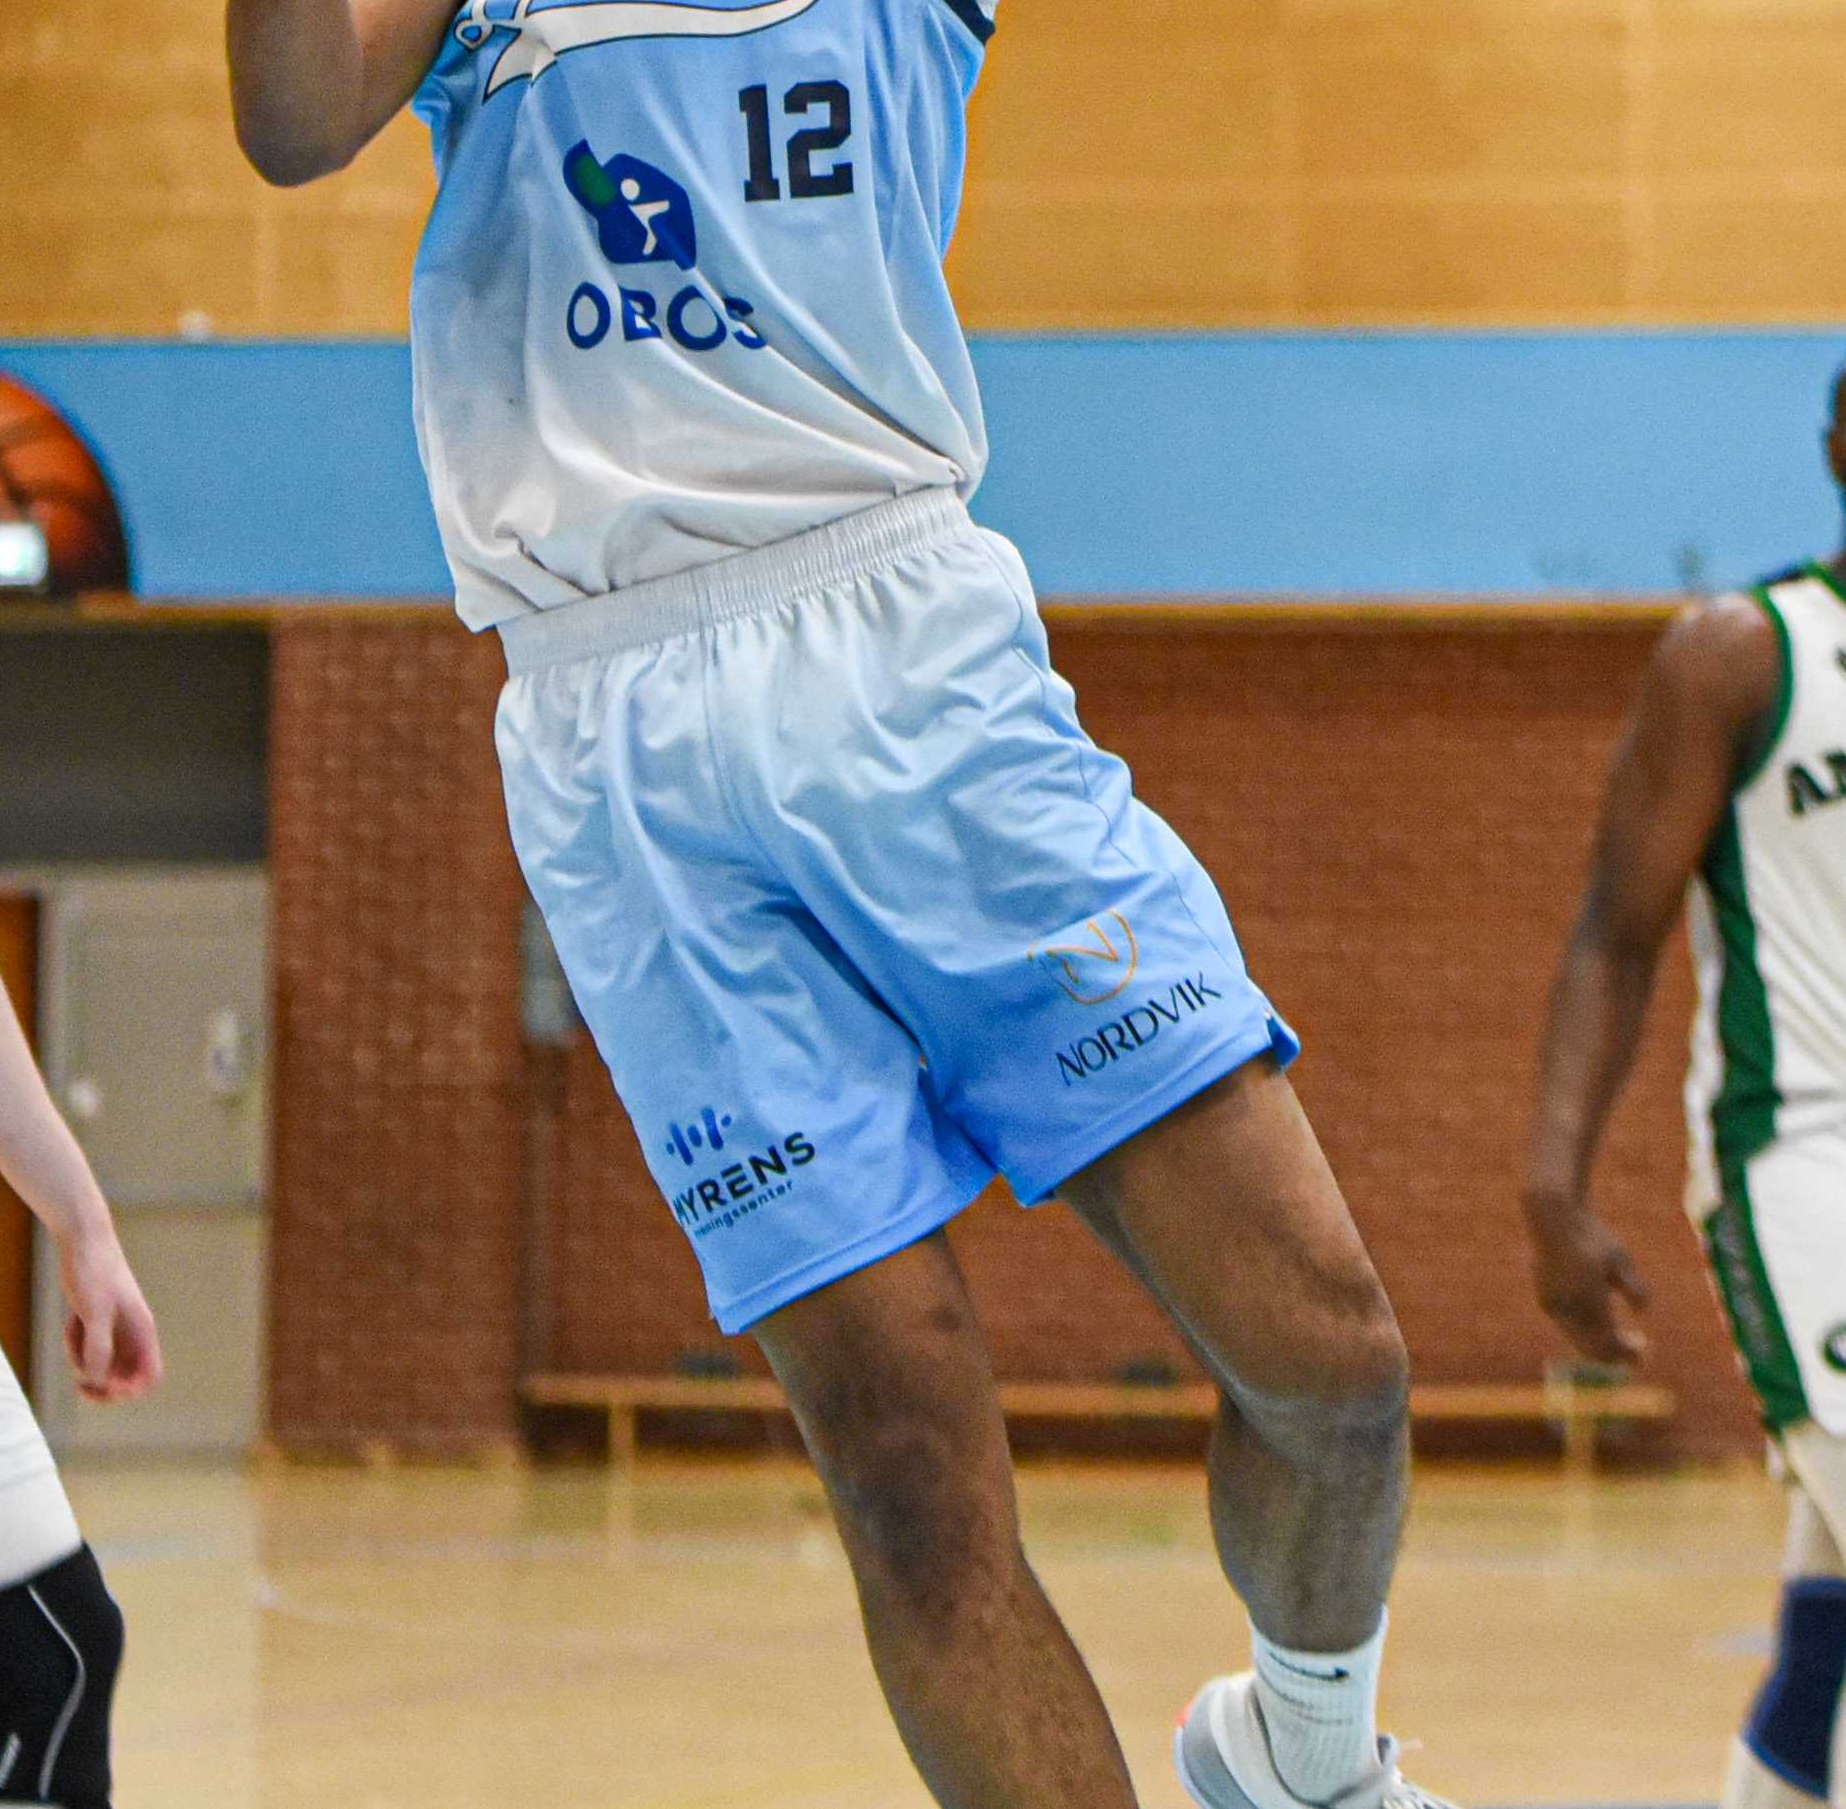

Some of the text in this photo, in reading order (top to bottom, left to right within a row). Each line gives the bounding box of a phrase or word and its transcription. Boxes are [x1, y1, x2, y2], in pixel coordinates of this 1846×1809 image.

[738, 79, 855, 203] 12
[565, 280, 768, 352] OBOS
[1054, 970, 1222, 1087] NORDVIK
